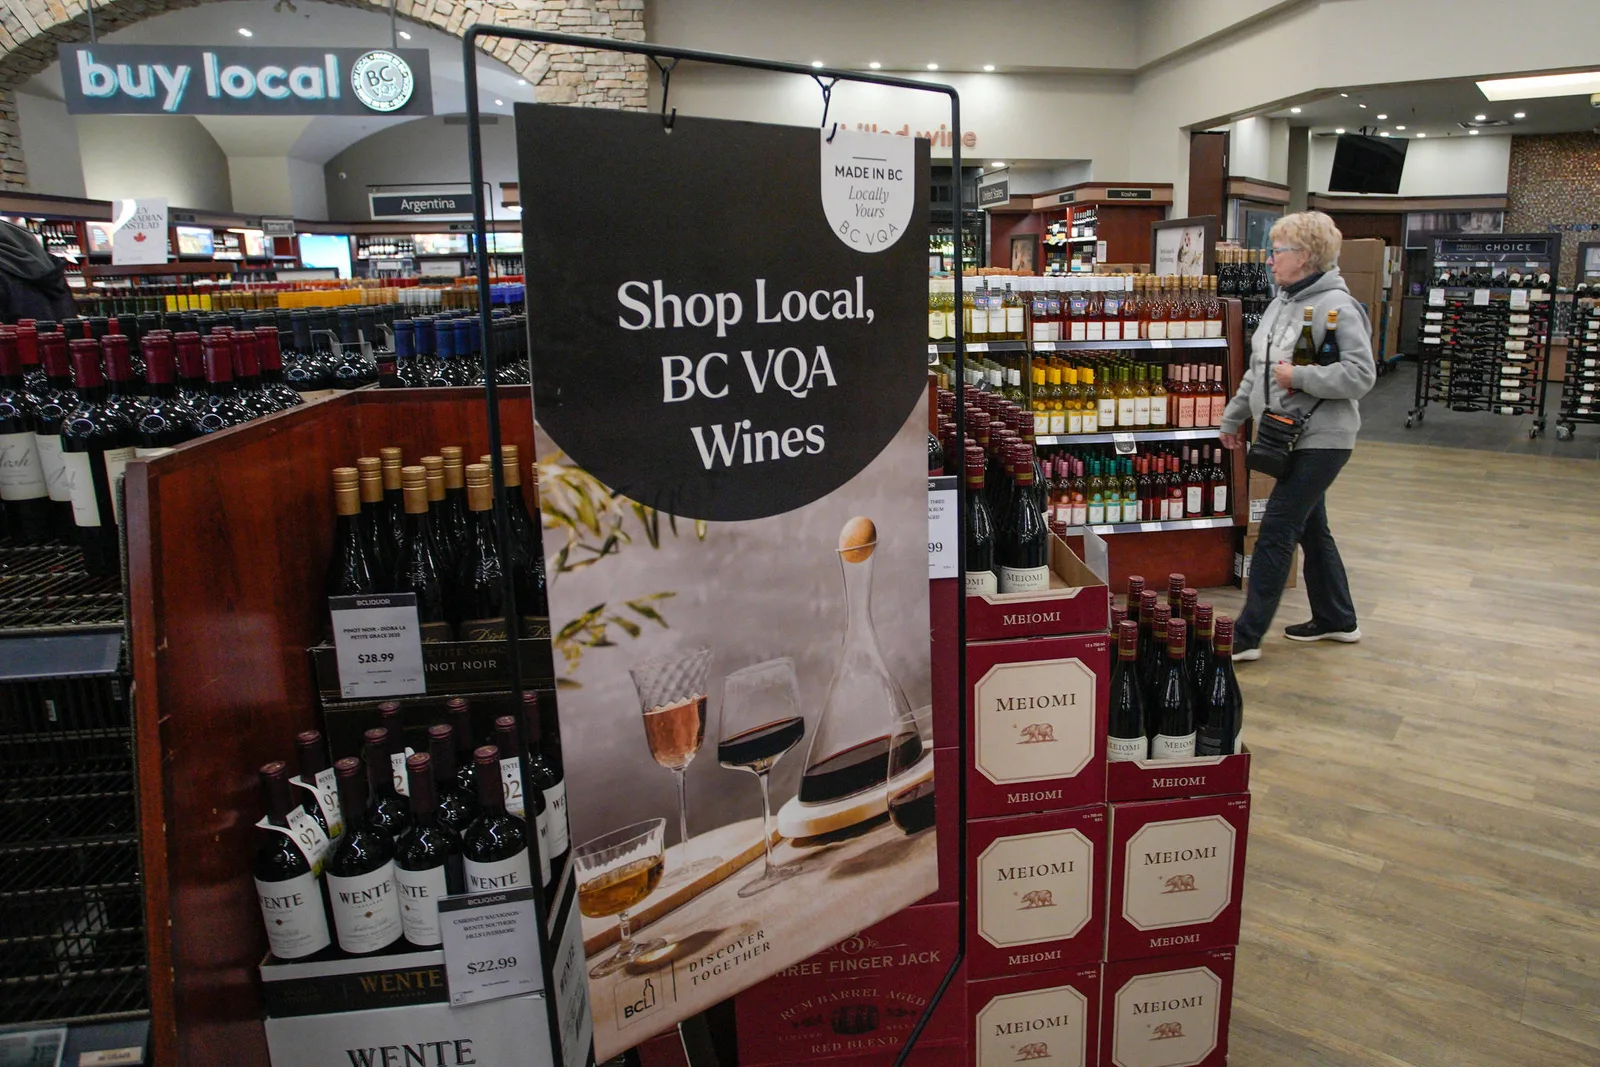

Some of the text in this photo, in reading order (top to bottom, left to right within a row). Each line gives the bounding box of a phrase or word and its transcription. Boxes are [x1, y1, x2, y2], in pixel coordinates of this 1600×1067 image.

[77, 49, 190, 112] buy
[203, 52, 341, 100] local
[366, 65, 394, 87] BC
[916, 123, 977, 148] wie
[834, 165, 904, 181] MADE IN BC
[848, 184, 890, 204] Locally
[400, 198, 456, 213] Argentina
[855, 202, 885, 218] Yours
[839, 220, 899, 246] BC VQA
[1485, 244, 1532, 252] CHOICE
[617, 275, 876, 338] Shop Local,
[661, 345, 838, 403] BC VQA
[690, 418, 826, 470] Wines
[1006, 572, 1043, 582] MEIOMI
[1002, 611, 1061, 626] MEIOMI
[358, 652, 394, 664] $28.99
[425, 660, 497, 672] INOT NOIR
[996, 693, 1076, 712] MEIOMI
[1152, 776, 1206, 788] MEIOMI
[1006, 789, 1063, 804] MEIOMI
[300, 828, 321, 850] 92
[1144, 846, 1217, 866] MEIOMI
[997, 860, 1075, 882] MEIOMI
[470, 872, 518, 890] WENTE
[338, 880, 392, 904] WENTE
[454, 915, 484, 924] CABERNET
[485, 910, 519, 920] SAUVIGNON
[485, 920, 516, 928] SOUTHERN
[1150, 933, 1200, 948] MEIOMI
[689, 930, 765, 973] DISCOVER
[1008, 950, 1062, 966] MEIOMI
[467, 956, 517, 974] $22.99
[690, 941, 771, 986] TOGETHER
[830, 955, 893, 973] FINGER
[898, 950, 941, 966] JACK
[359, 969, 443, 994] WENTE
[817, 988, 880, 1006] BARREL
[886, 990, 926, 1007] AGED
[1132, 996, 1204, 1016] MEIOMI
[995, 1014, 1070, 1036] MEIOMI
[346, 1038, 476, 1067] WENTE
[811, 1036, 899, 1054] RED BLEND
